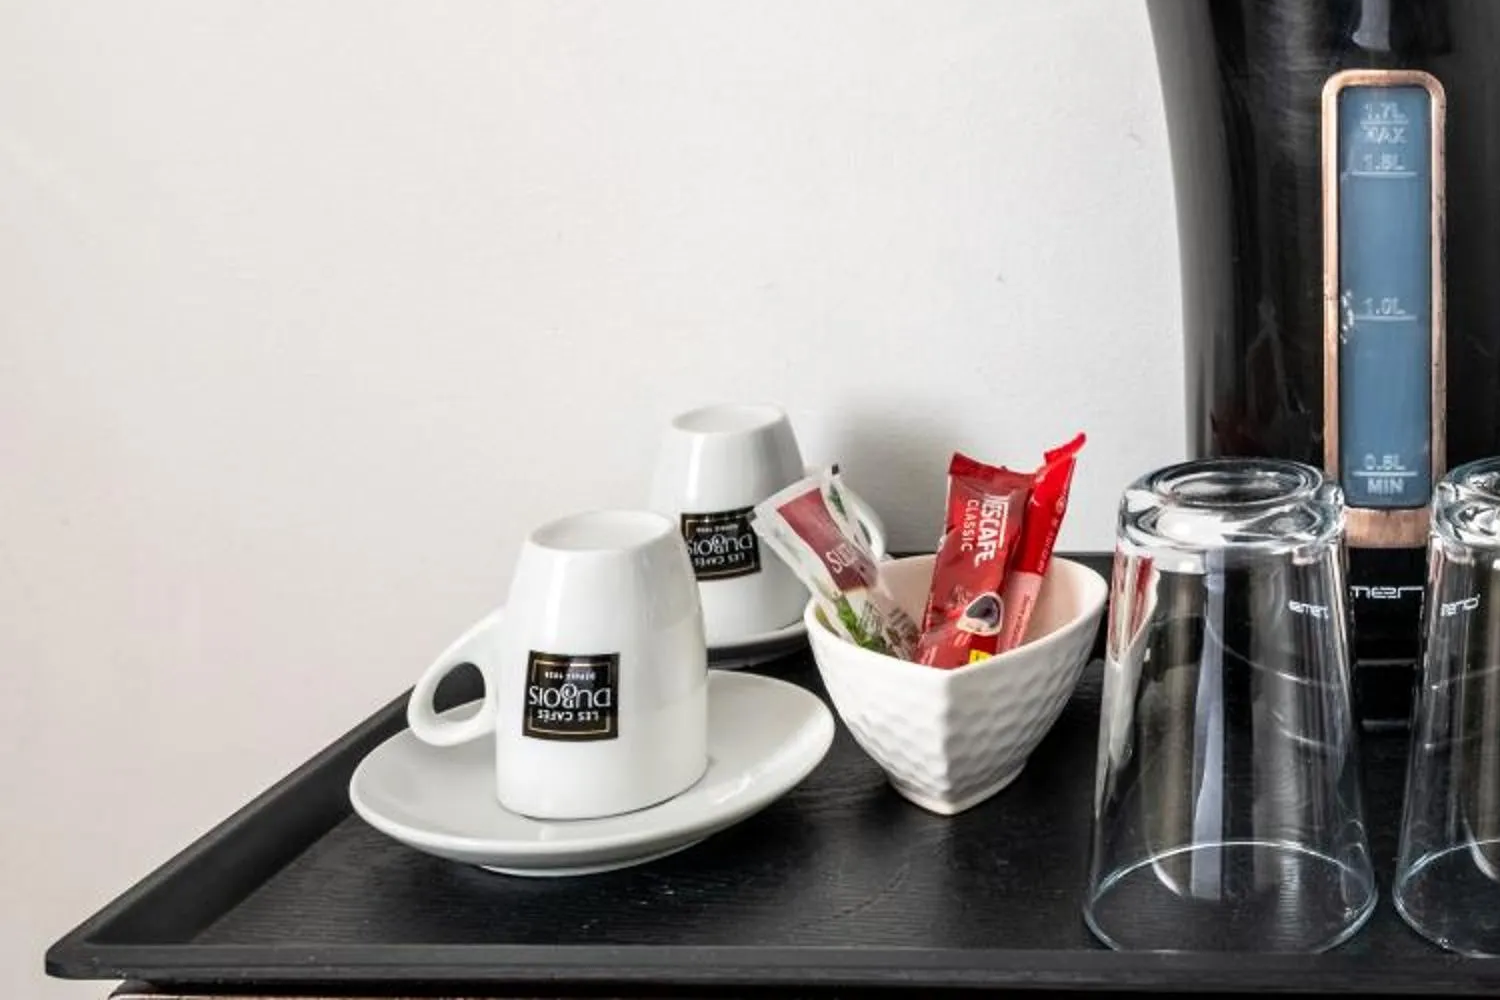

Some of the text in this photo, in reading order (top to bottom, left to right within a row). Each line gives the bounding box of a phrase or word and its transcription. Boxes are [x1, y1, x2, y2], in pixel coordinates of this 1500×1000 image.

[1366, 477, 1404, 495] MIN
[961, 500, 979, 553] CLASSIC
[528, 682, 611, 709] DUBOIS
[577, 710, 599, 722] LES
